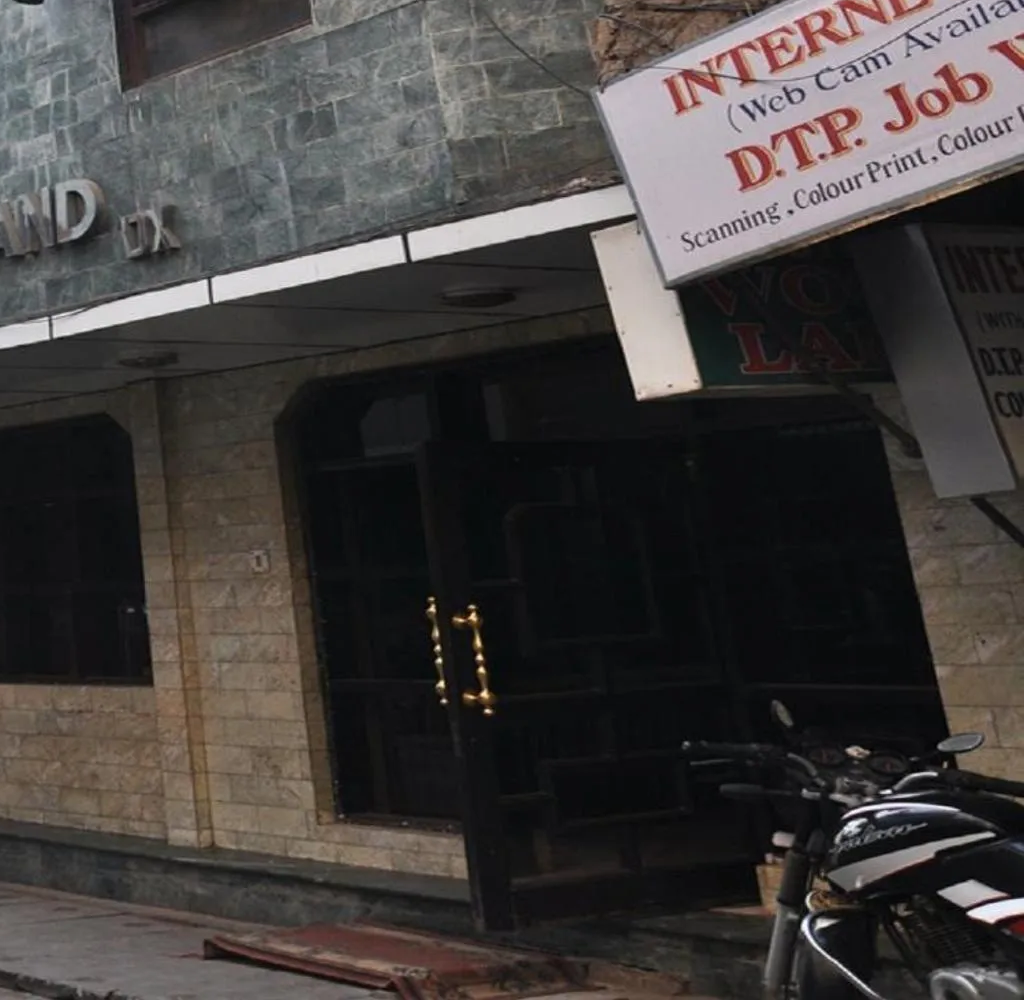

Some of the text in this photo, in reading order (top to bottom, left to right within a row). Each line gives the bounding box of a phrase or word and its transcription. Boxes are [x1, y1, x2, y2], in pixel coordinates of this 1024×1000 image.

[814, 50, 893, 93] Cam
[882, 61, 994, 136] Job
[937, 114, 1015, 157] Colour
